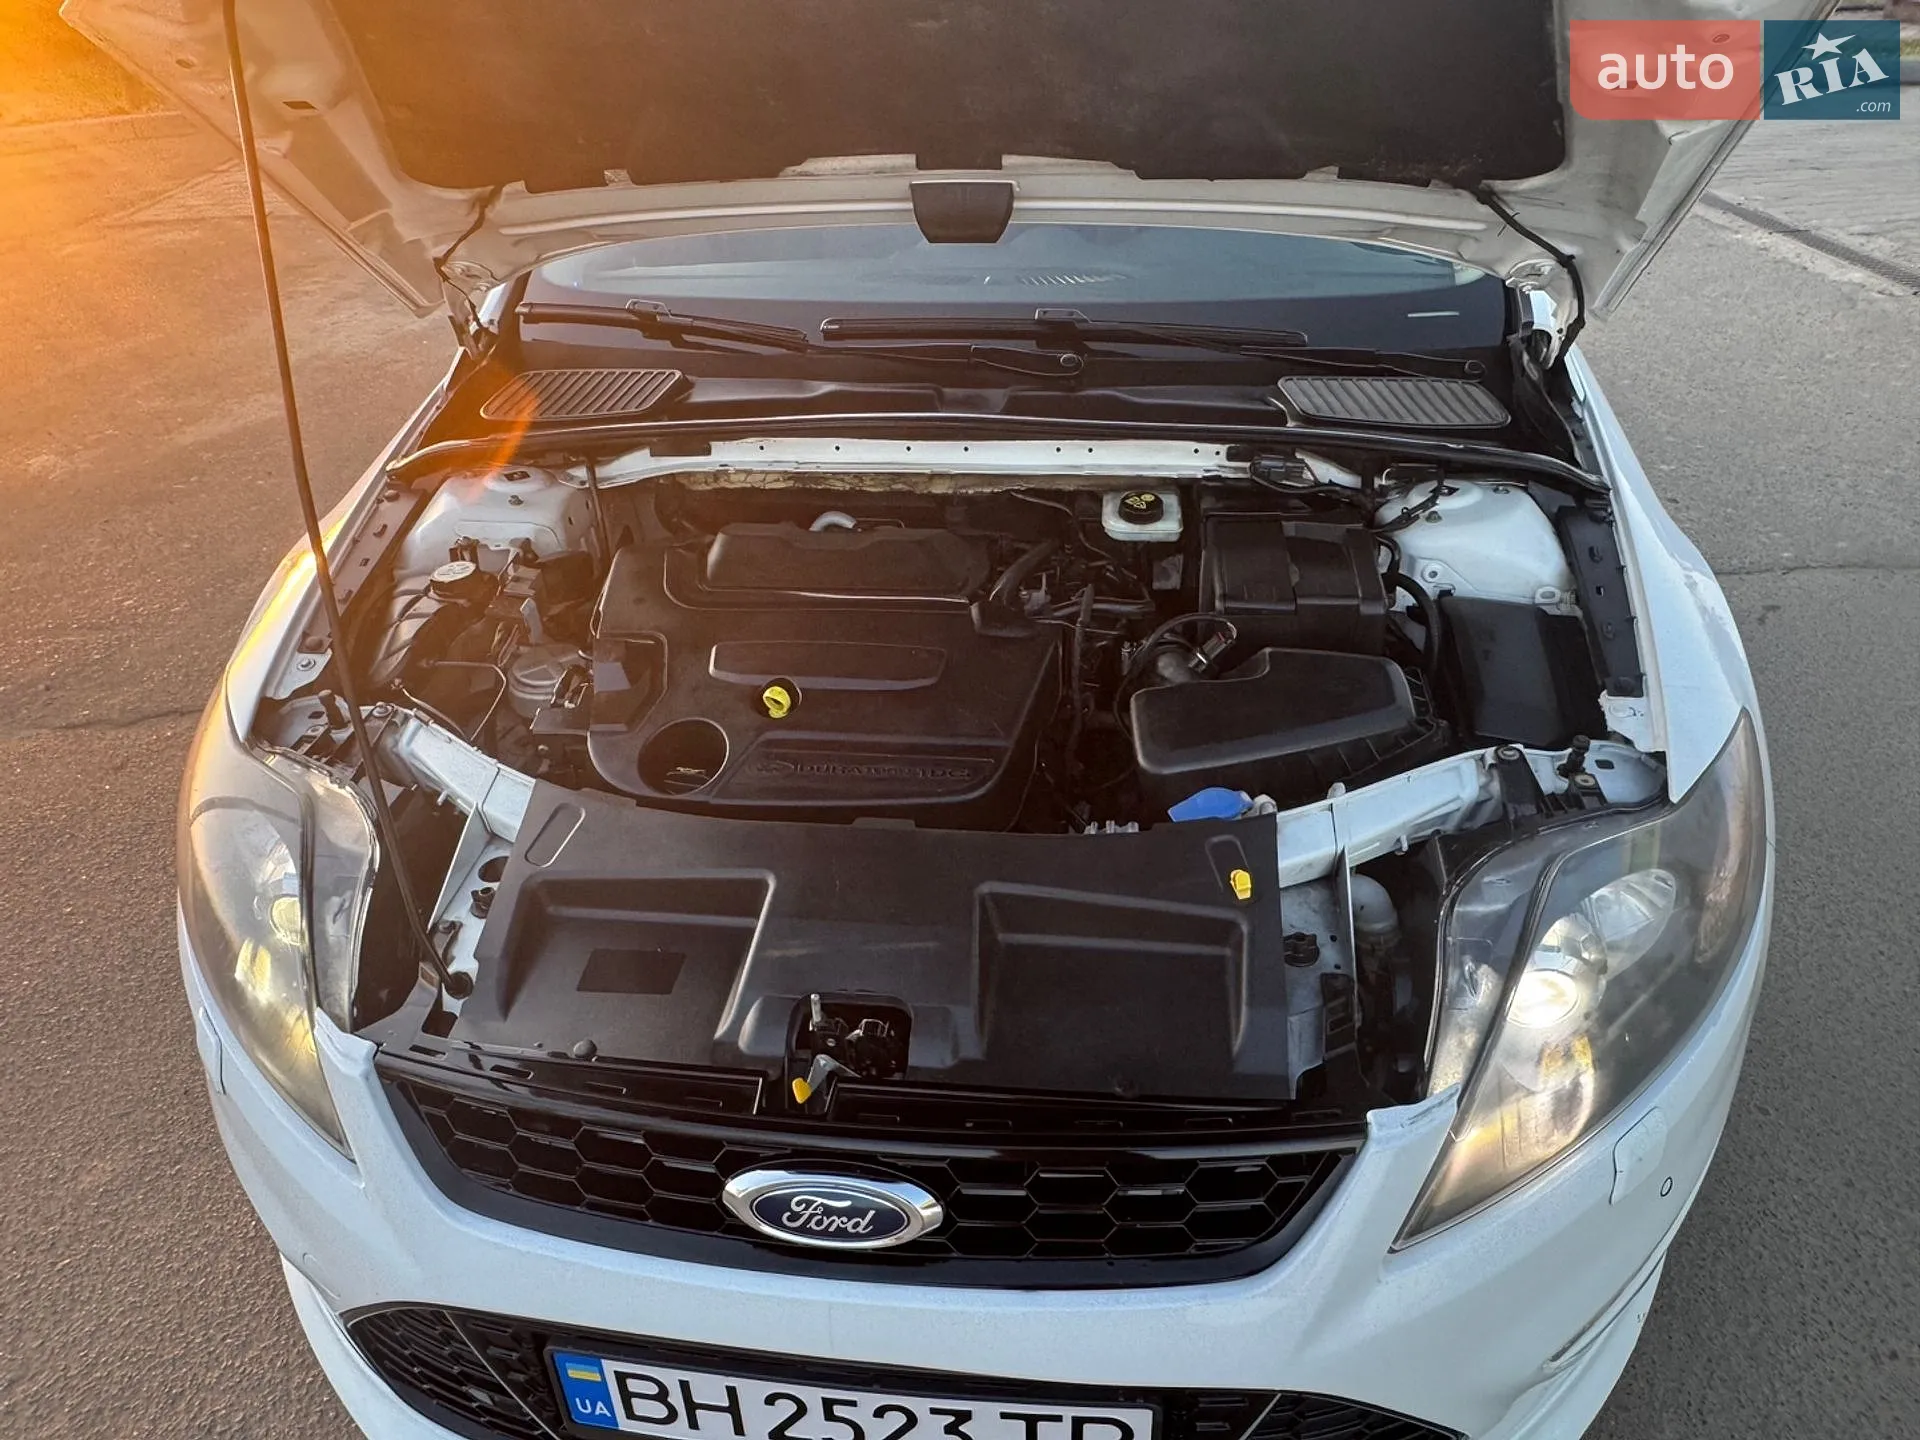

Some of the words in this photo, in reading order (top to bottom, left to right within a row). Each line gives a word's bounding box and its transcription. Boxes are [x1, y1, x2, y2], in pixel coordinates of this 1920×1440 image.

[781, 1195, 876, 1234] Ford
[575, 1397, 612, 1418] UA
[613, 1370, 746, 1437] BH
[763, 1391, 975, 1440] 2523
